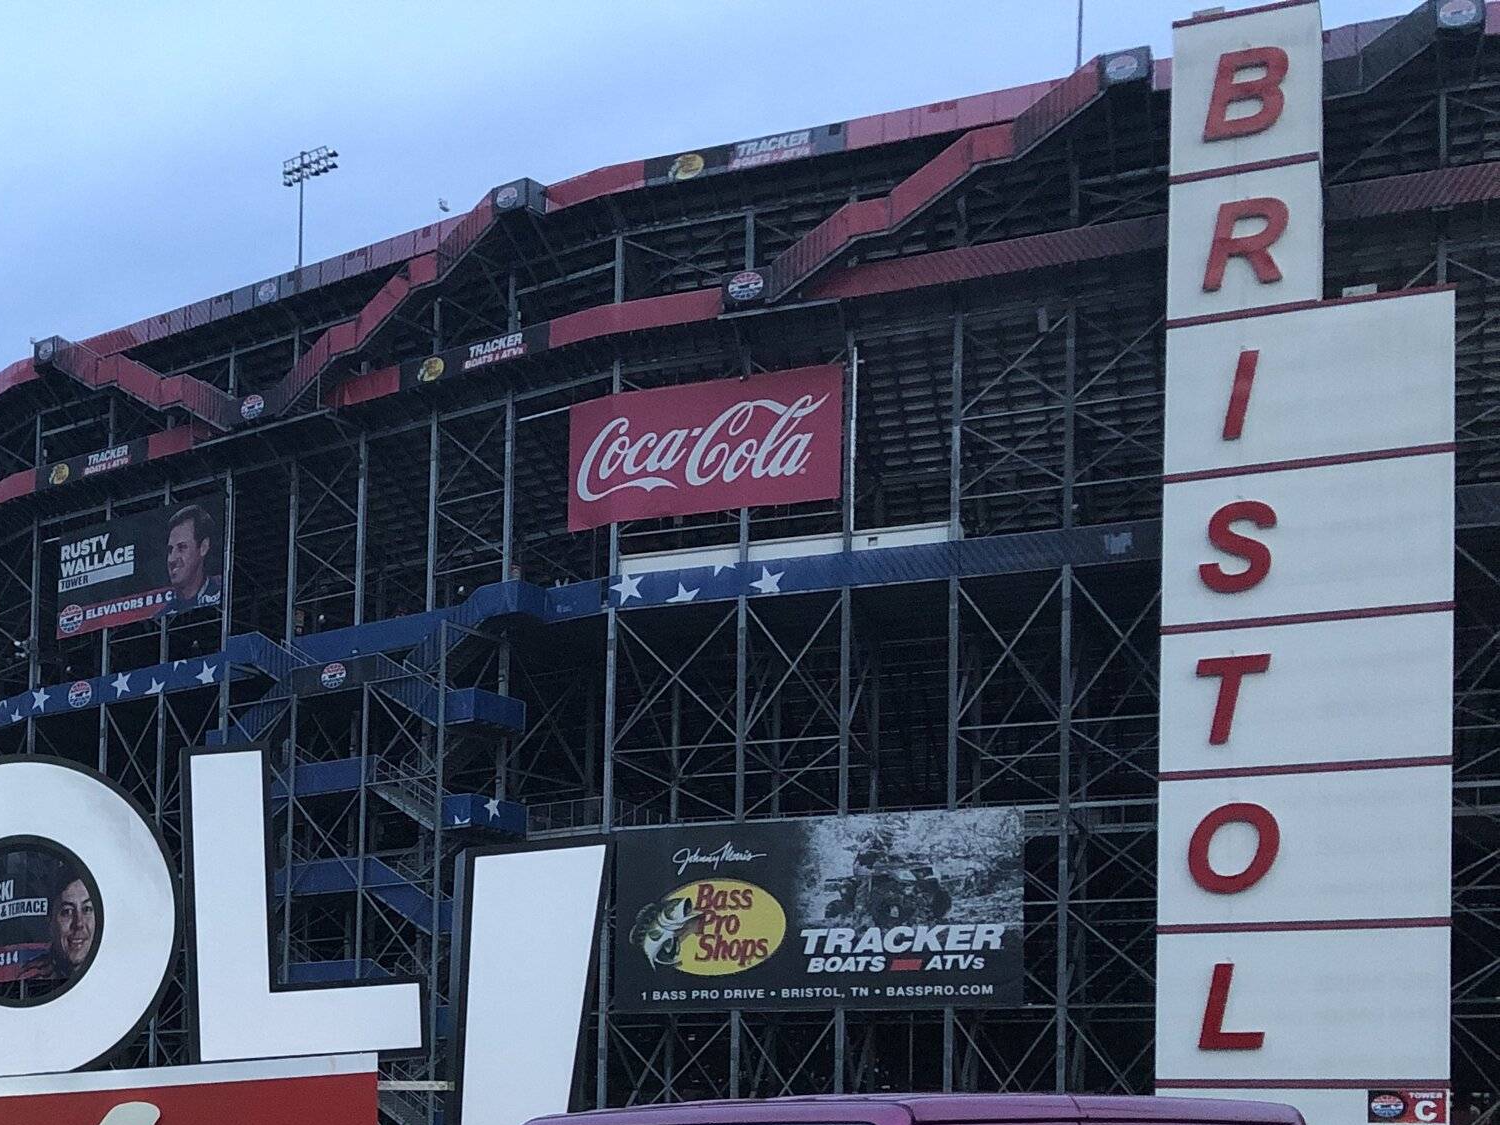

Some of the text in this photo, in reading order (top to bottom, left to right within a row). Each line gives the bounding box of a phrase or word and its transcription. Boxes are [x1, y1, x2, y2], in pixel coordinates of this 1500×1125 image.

[737, 130, 812, 158] TRACKER
[468, 332, 523, 359] TRACKER
[87, 444, 129, 466] TRACKER
[577, 391, 831, 502] Coca-Cola
[60, 533, 110, 562] RUSTY
[60, 544, 135, 578] WALLACE
[1187, 46, 1290, 1050] BRISTOL
[60, 575, 89, 591] TOWER
[85, 590, 173, 621] ELEVATORS B & C
[694, 883, 754, 911] Bass
[697, 909, 741, 936] Pro
[694, 933, 769, 968] Shops
[800, 923, 1004, 955] TRACKER
[0, 952, 5, 966] 3
[12, 950, 19, 963] 4
[807, 953, 986, 974] BOATS ATVs
[641, 984, 994, 1000] 1 BASS PRO DRIVE BRISTOL, TN BASSPRO.COM
[1408, 1091, 1443, 1099] TOWER
[1414, 1100, 1438, 1122] C
